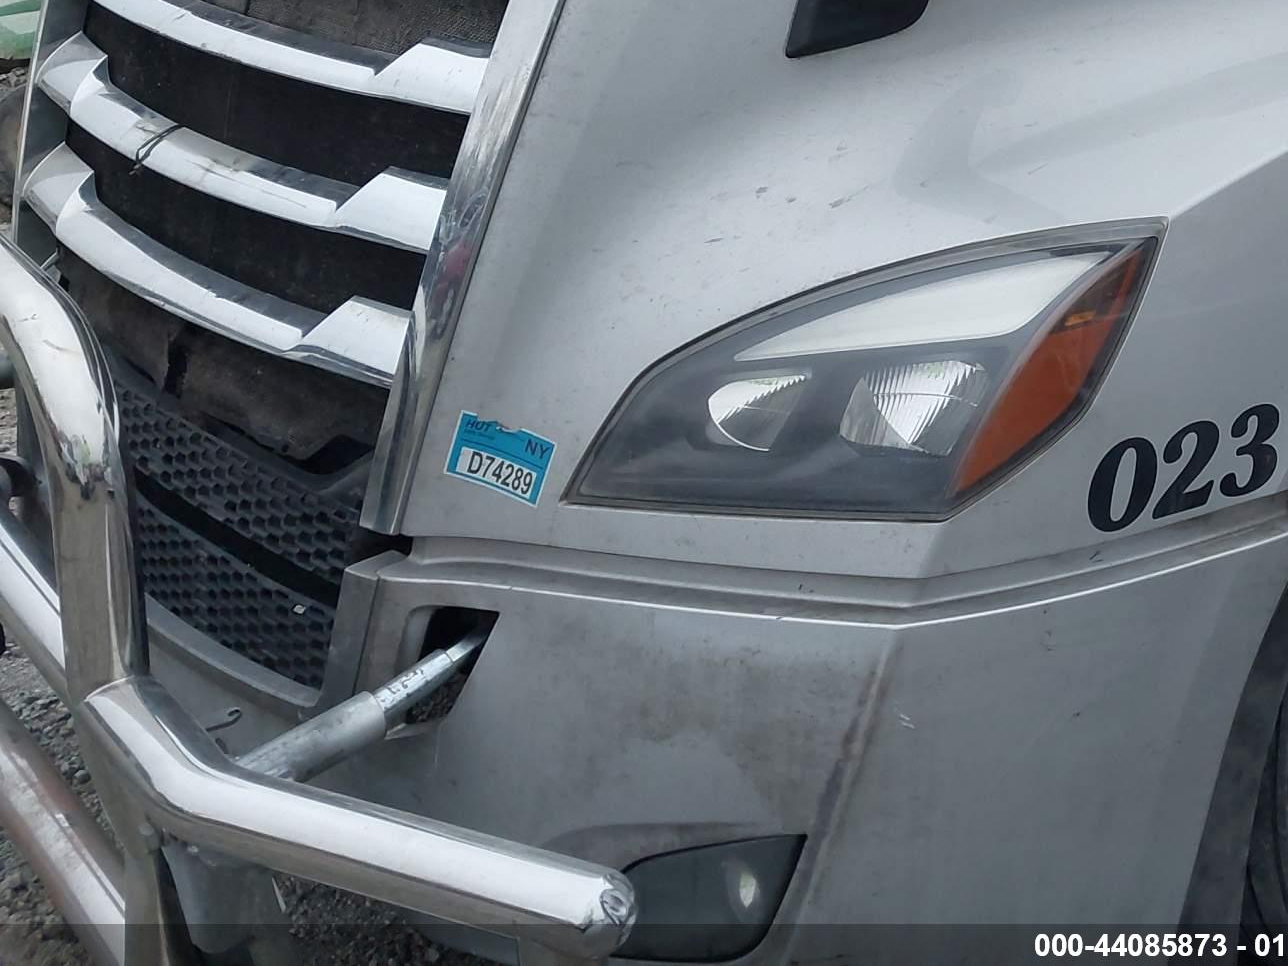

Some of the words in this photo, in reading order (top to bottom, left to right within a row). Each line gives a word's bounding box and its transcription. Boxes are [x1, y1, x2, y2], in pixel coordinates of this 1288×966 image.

[524, 438, 551, 459] NY
[1087, 403, 1280, 533] 023
[466, 450, 533, 495] D74289
